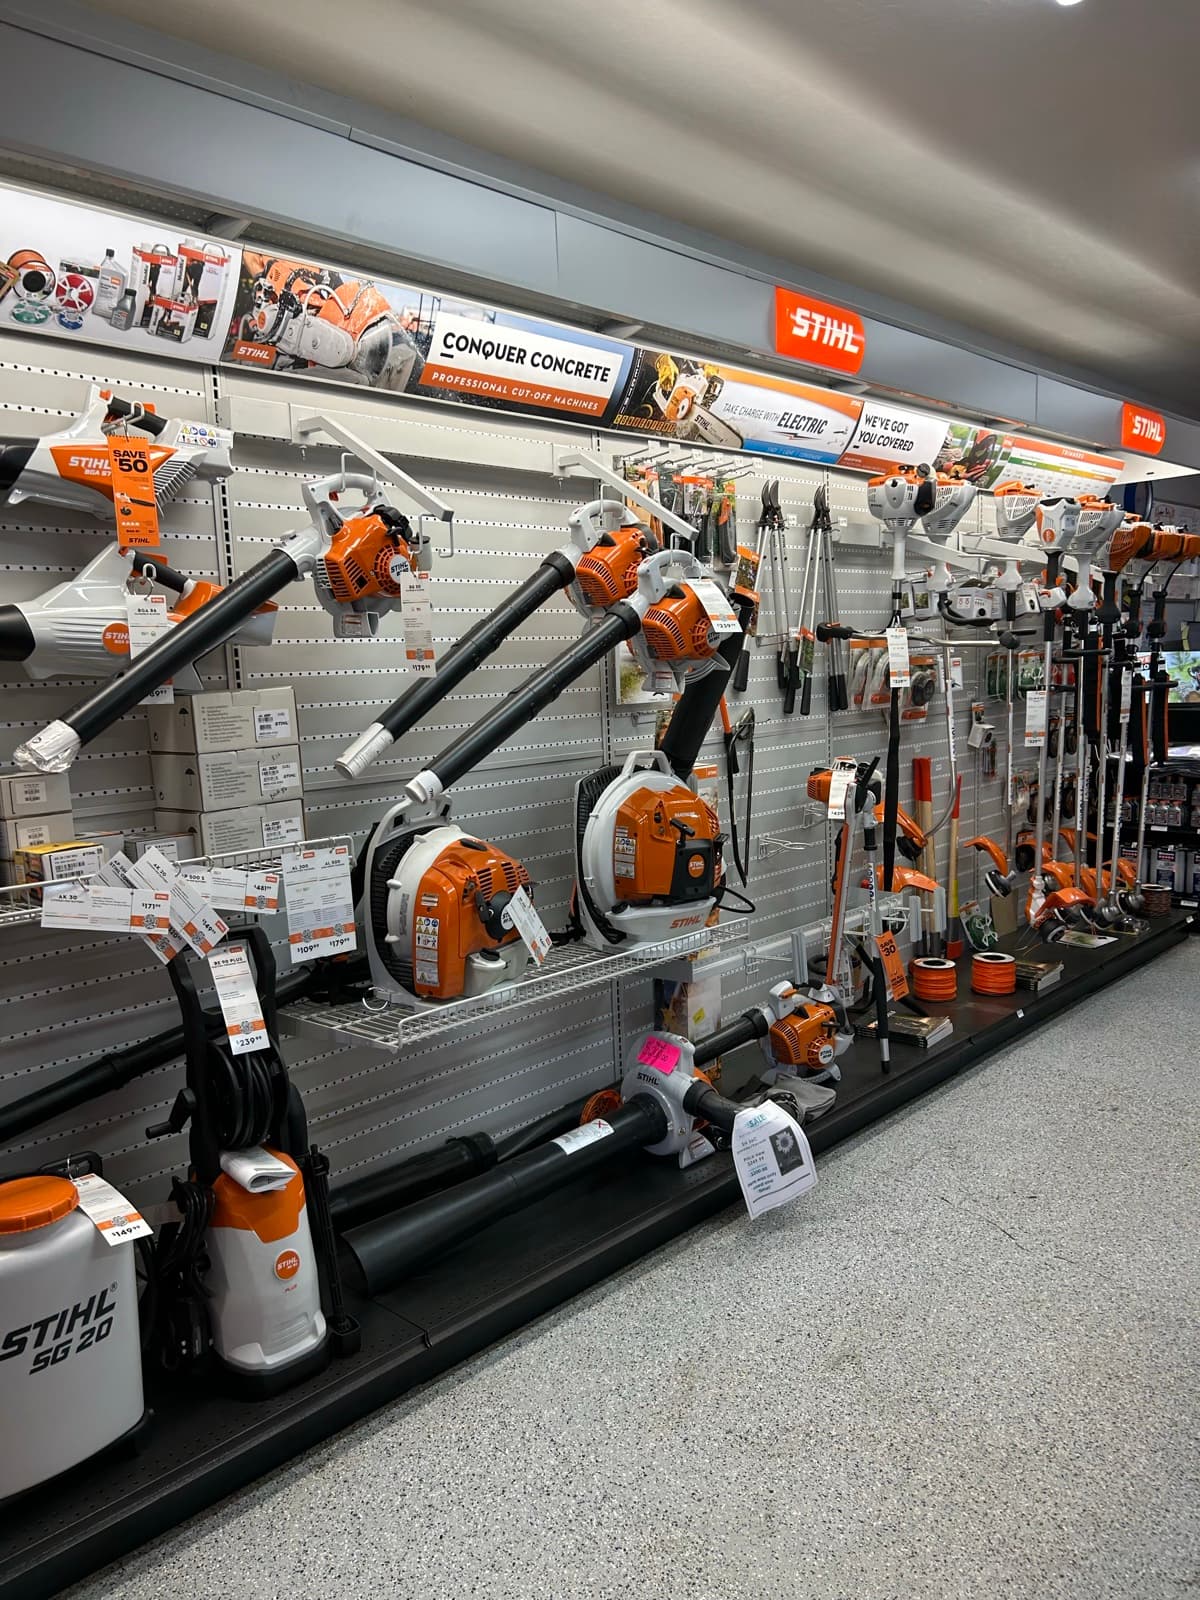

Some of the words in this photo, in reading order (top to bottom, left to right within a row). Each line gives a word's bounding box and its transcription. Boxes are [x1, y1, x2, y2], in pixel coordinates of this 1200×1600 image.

[791, 307, 860, 354] STIHL
[237, 346, 270, 360] STIHL
[443, 332, 526, 365] CONQUER
[530, 354, 611, 383] CONCRETE
[432, 371, 508, 394] PROFESSIONAL
[511, 387, 552, 403] CUT-OFF
[553, 395, 599, 411] MACHINES
[694, 414, 710, 431] STIHL
[722, 403, 737, 415] TAKE
[738, 407, 765, 419] CHARGE
[763, 411, 780, 421] WITH
[777, 411, 828, 435] ELECTRIC
[865, 413, 891, 431] WE'VE
[891, 420, 909, 434] GOT
[1132, 415, 1162, 442] STIHL
[858, 430, 877, 444] YOU
[876, 434, 914, 452] COVERED
[113, 449, 146, 459] SAVE
[69, 456, 111, 470] STIHL
[391, 560, 409, 573] STIHL
[104, 632, 129, 640] STIH
[670, 915, 702, 929] STIHL
[637, 1072, 659, 1086] STIHL
[748, 1114, 767, 1128] SALE
[278, 1257, 298, 1270] STIHL
[0, 1287, 117, 1362] STIHL
[29, 1338, 73, 1375] SG
[75, 1316, 114, 1354] 20
